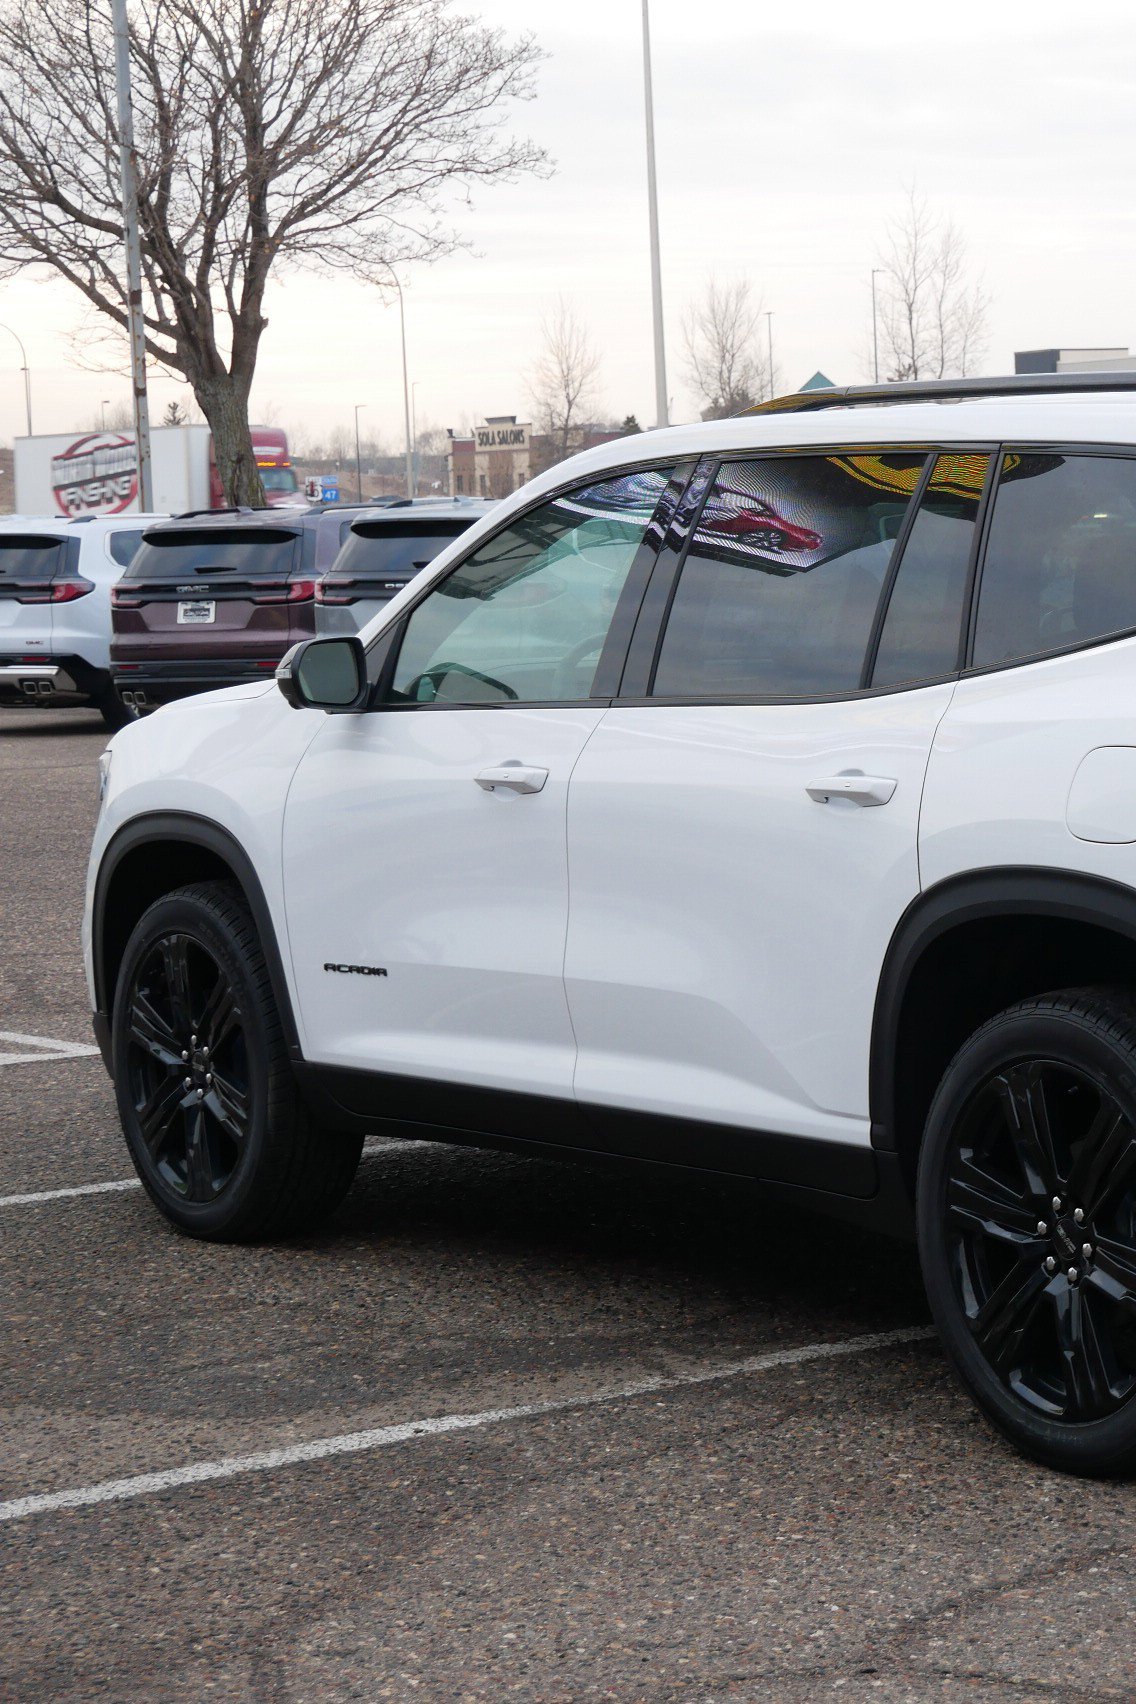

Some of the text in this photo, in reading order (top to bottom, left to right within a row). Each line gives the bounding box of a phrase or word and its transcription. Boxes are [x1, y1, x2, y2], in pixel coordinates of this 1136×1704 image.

[478, 429, 525, 447] SOLA SALONS
[324, 490, 337, 500] 47
[323, 963, 388, 977] ACADIA
